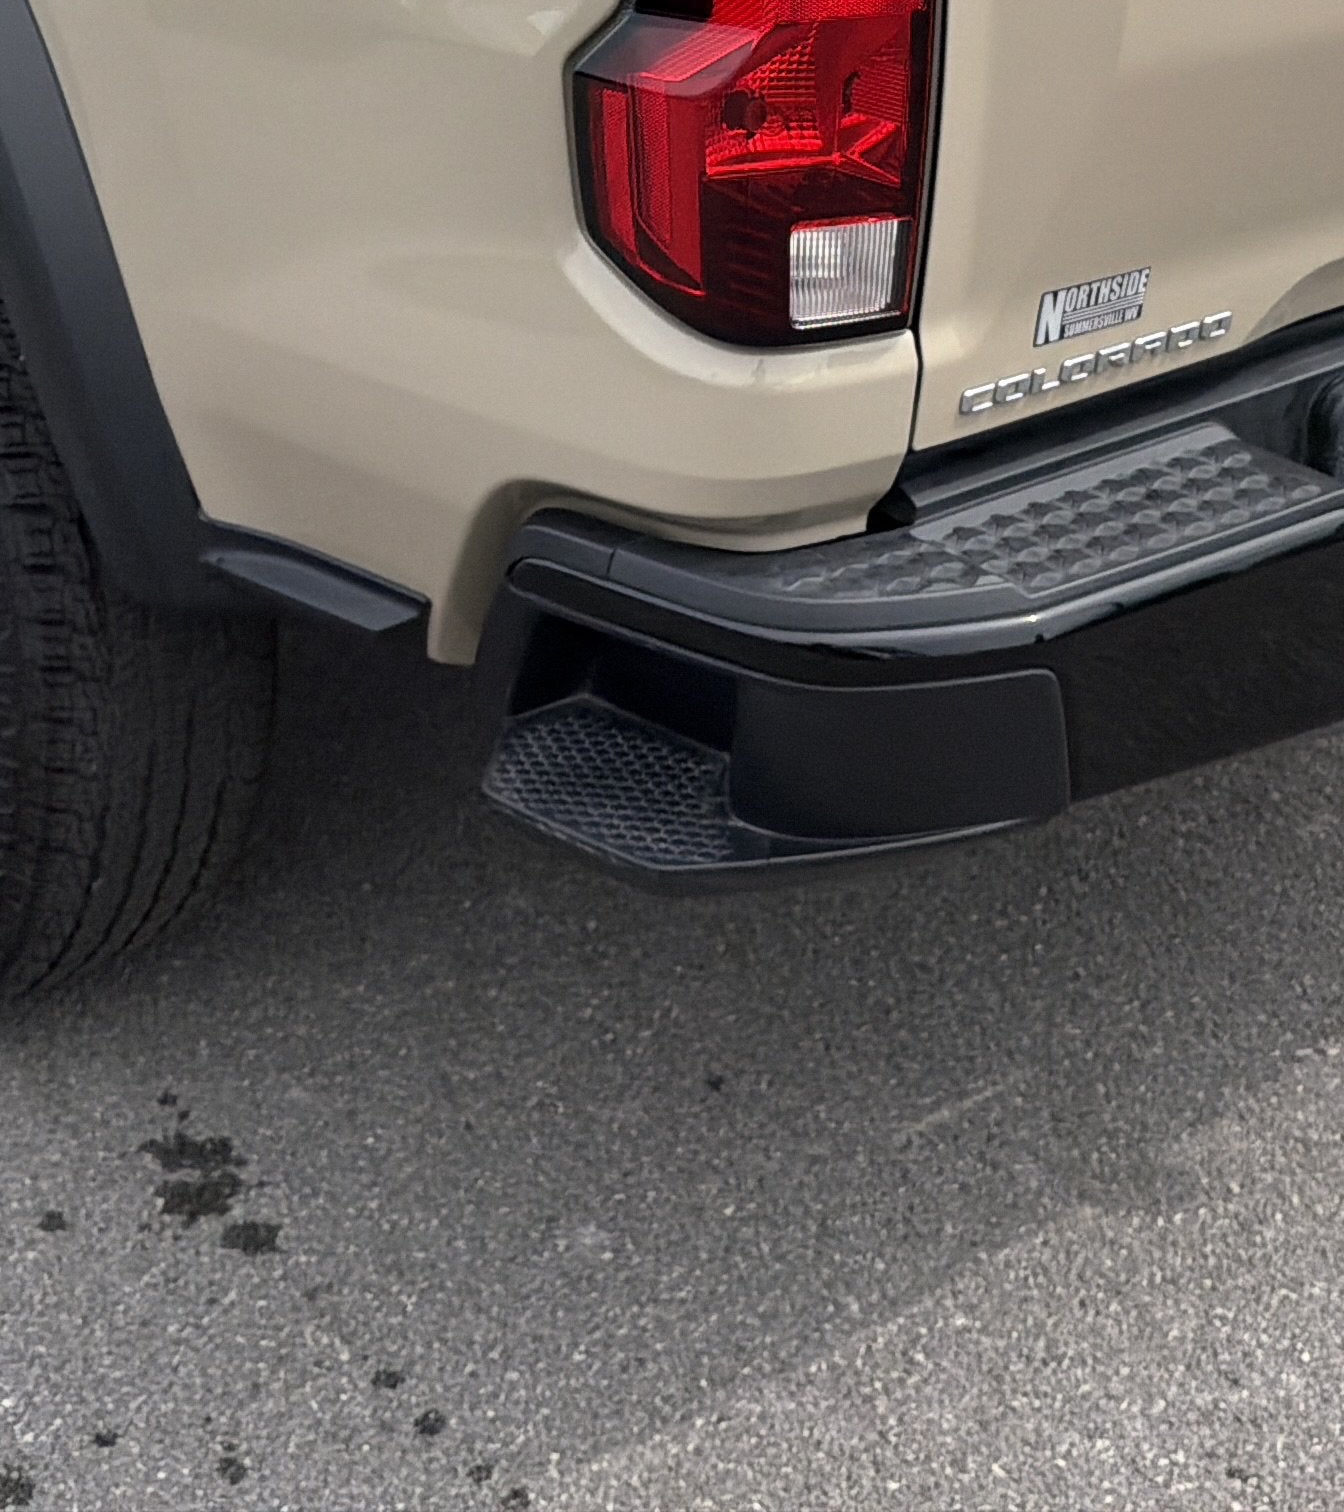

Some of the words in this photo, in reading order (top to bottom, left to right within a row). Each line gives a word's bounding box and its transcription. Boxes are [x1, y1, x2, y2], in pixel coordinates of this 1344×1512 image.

[1035, 268, 1151, 346] NORTHSIDE
[1063, 308, 1125, 339] SUMMERSVILLE
[1124, 304, 1141, 321] WV
[958, 310, 1233, 415] COLORADO
